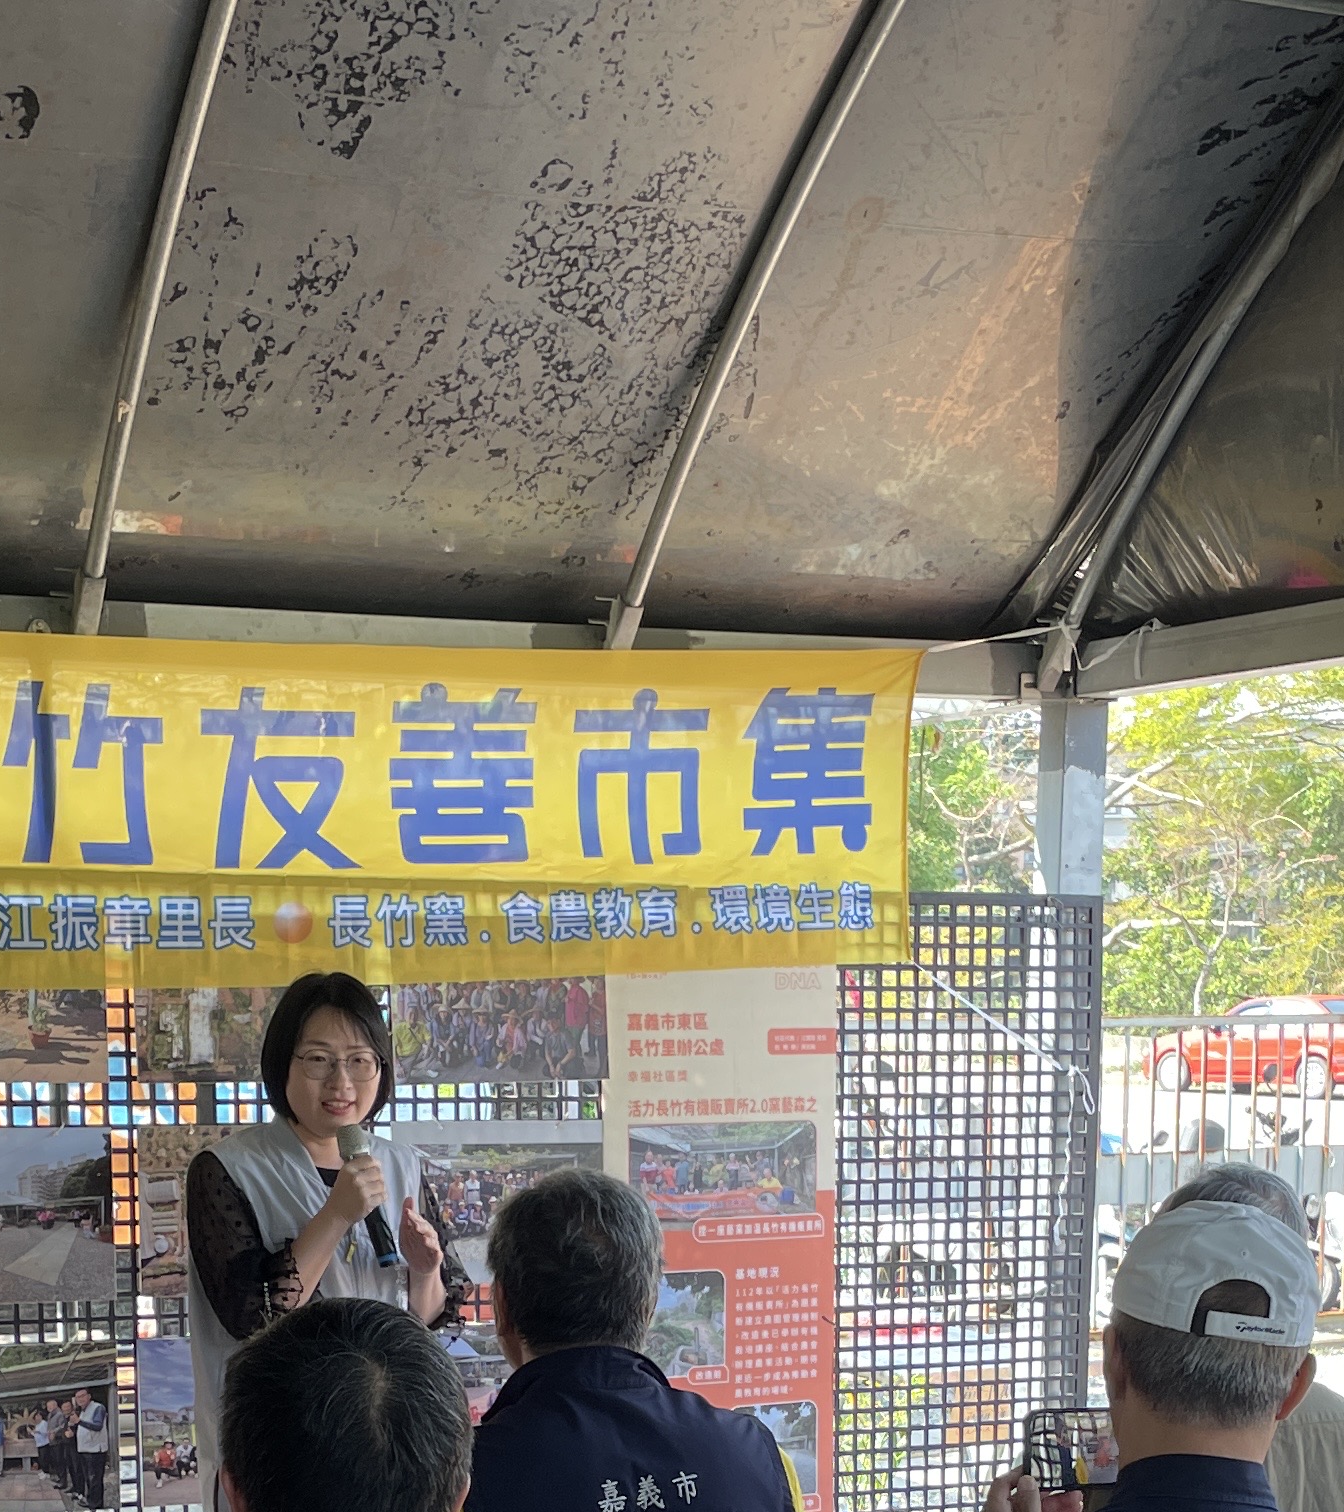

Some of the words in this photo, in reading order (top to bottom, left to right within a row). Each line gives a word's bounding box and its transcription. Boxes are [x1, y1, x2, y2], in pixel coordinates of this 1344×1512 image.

[775, 972, 821, 990] DNA
[627, 1013, 709, 1031] 嘉義市東區
[627, 1038, 725, 1057] 長竹里辦公處
[1235, 1322, 1286, 1335] TaylorMade
